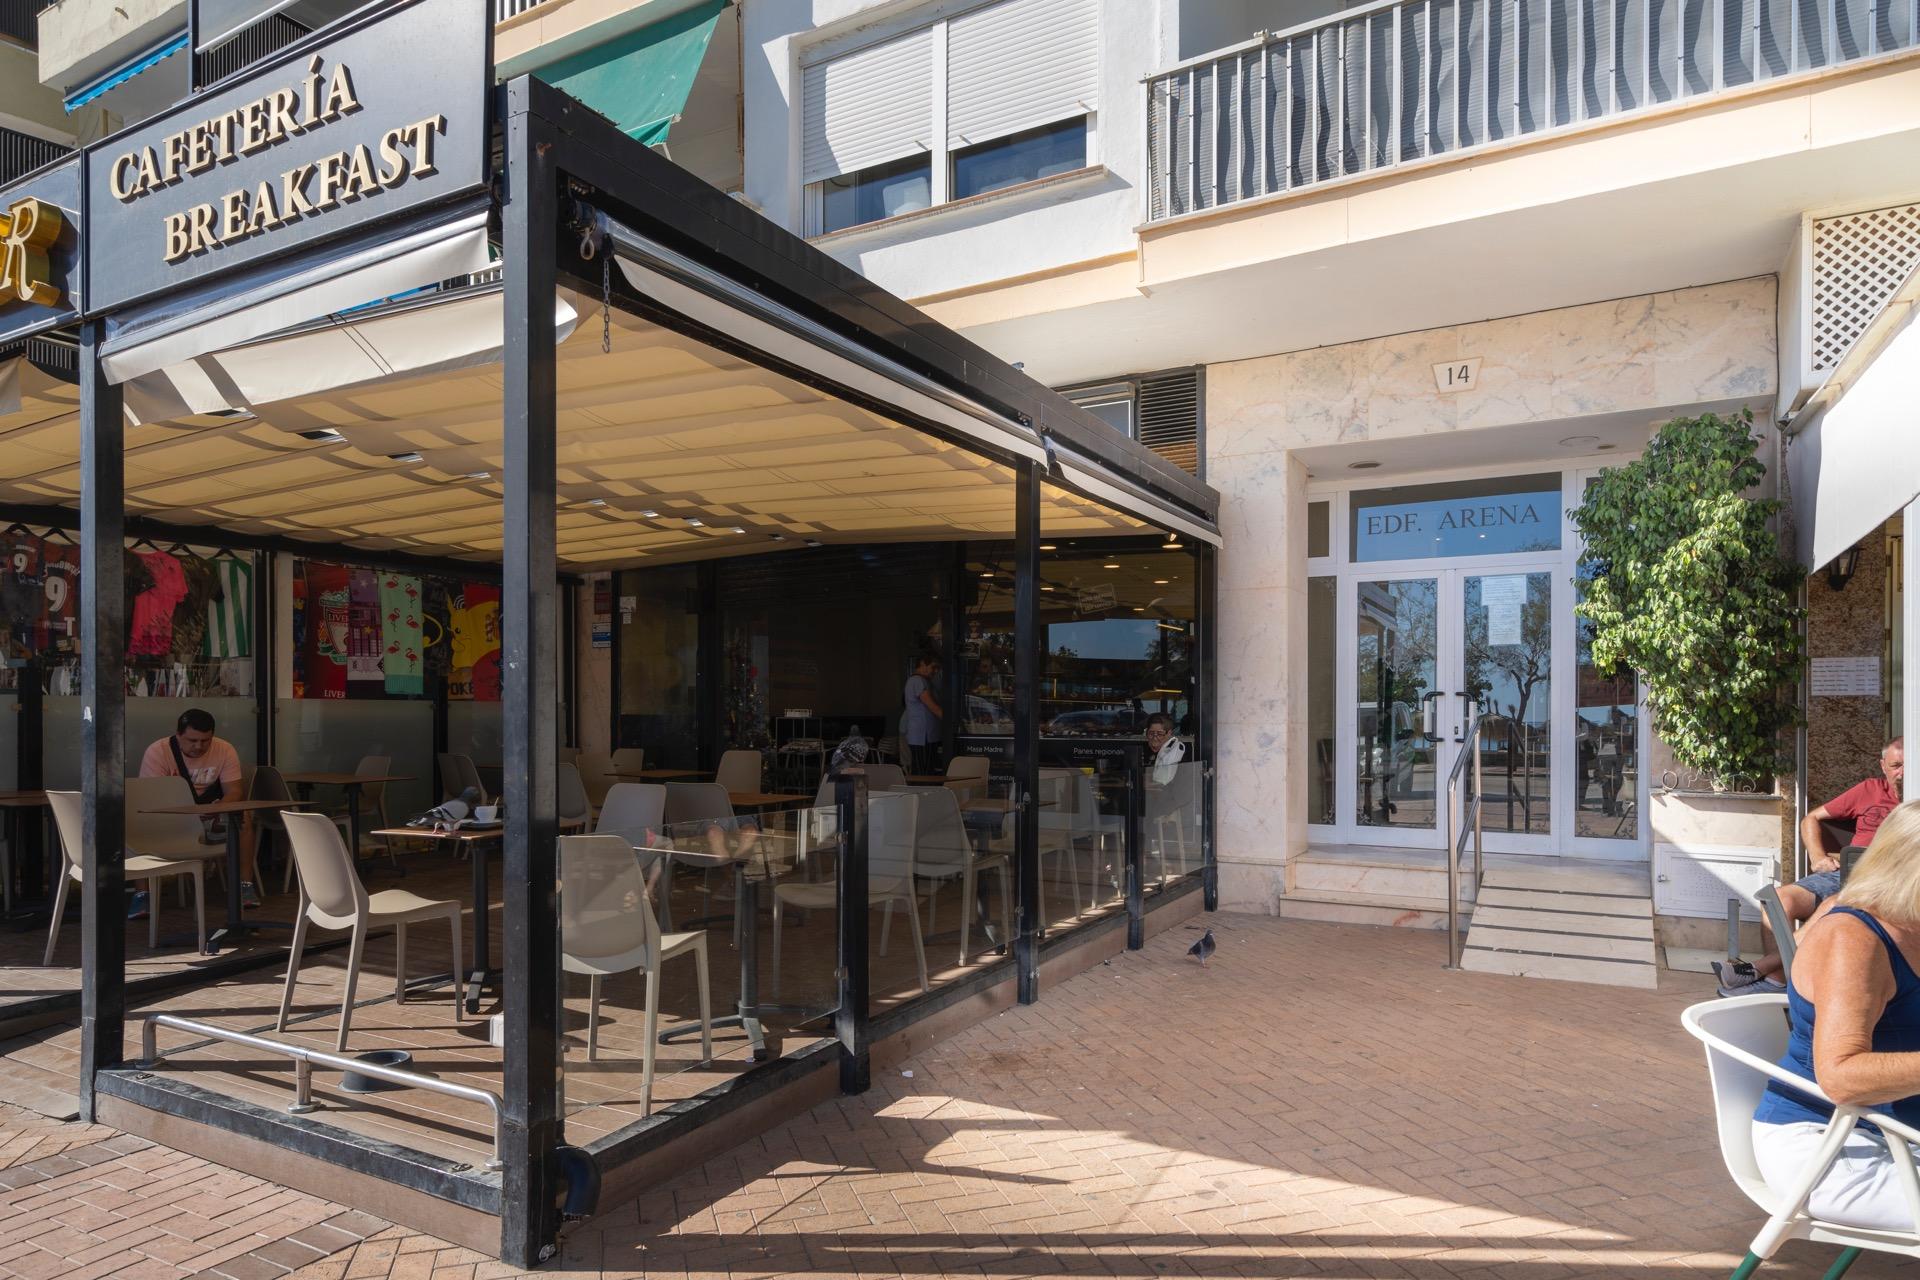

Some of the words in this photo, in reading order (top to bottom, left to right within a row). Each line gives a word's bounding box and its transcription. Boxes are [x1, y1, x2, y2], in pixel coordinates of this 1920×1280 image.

[110, 54, 358, 201] CAFETERÍA
[163, 113, 443, 262] BREAKFAST
[1447, 364, 1470, 386] 14
[1366, 512, 1422, 536] EDF.
[1437, 503, 1542, 530] ARENA
[13, 552, 28, 573] 9
[44, 575, 68, 613] 9
